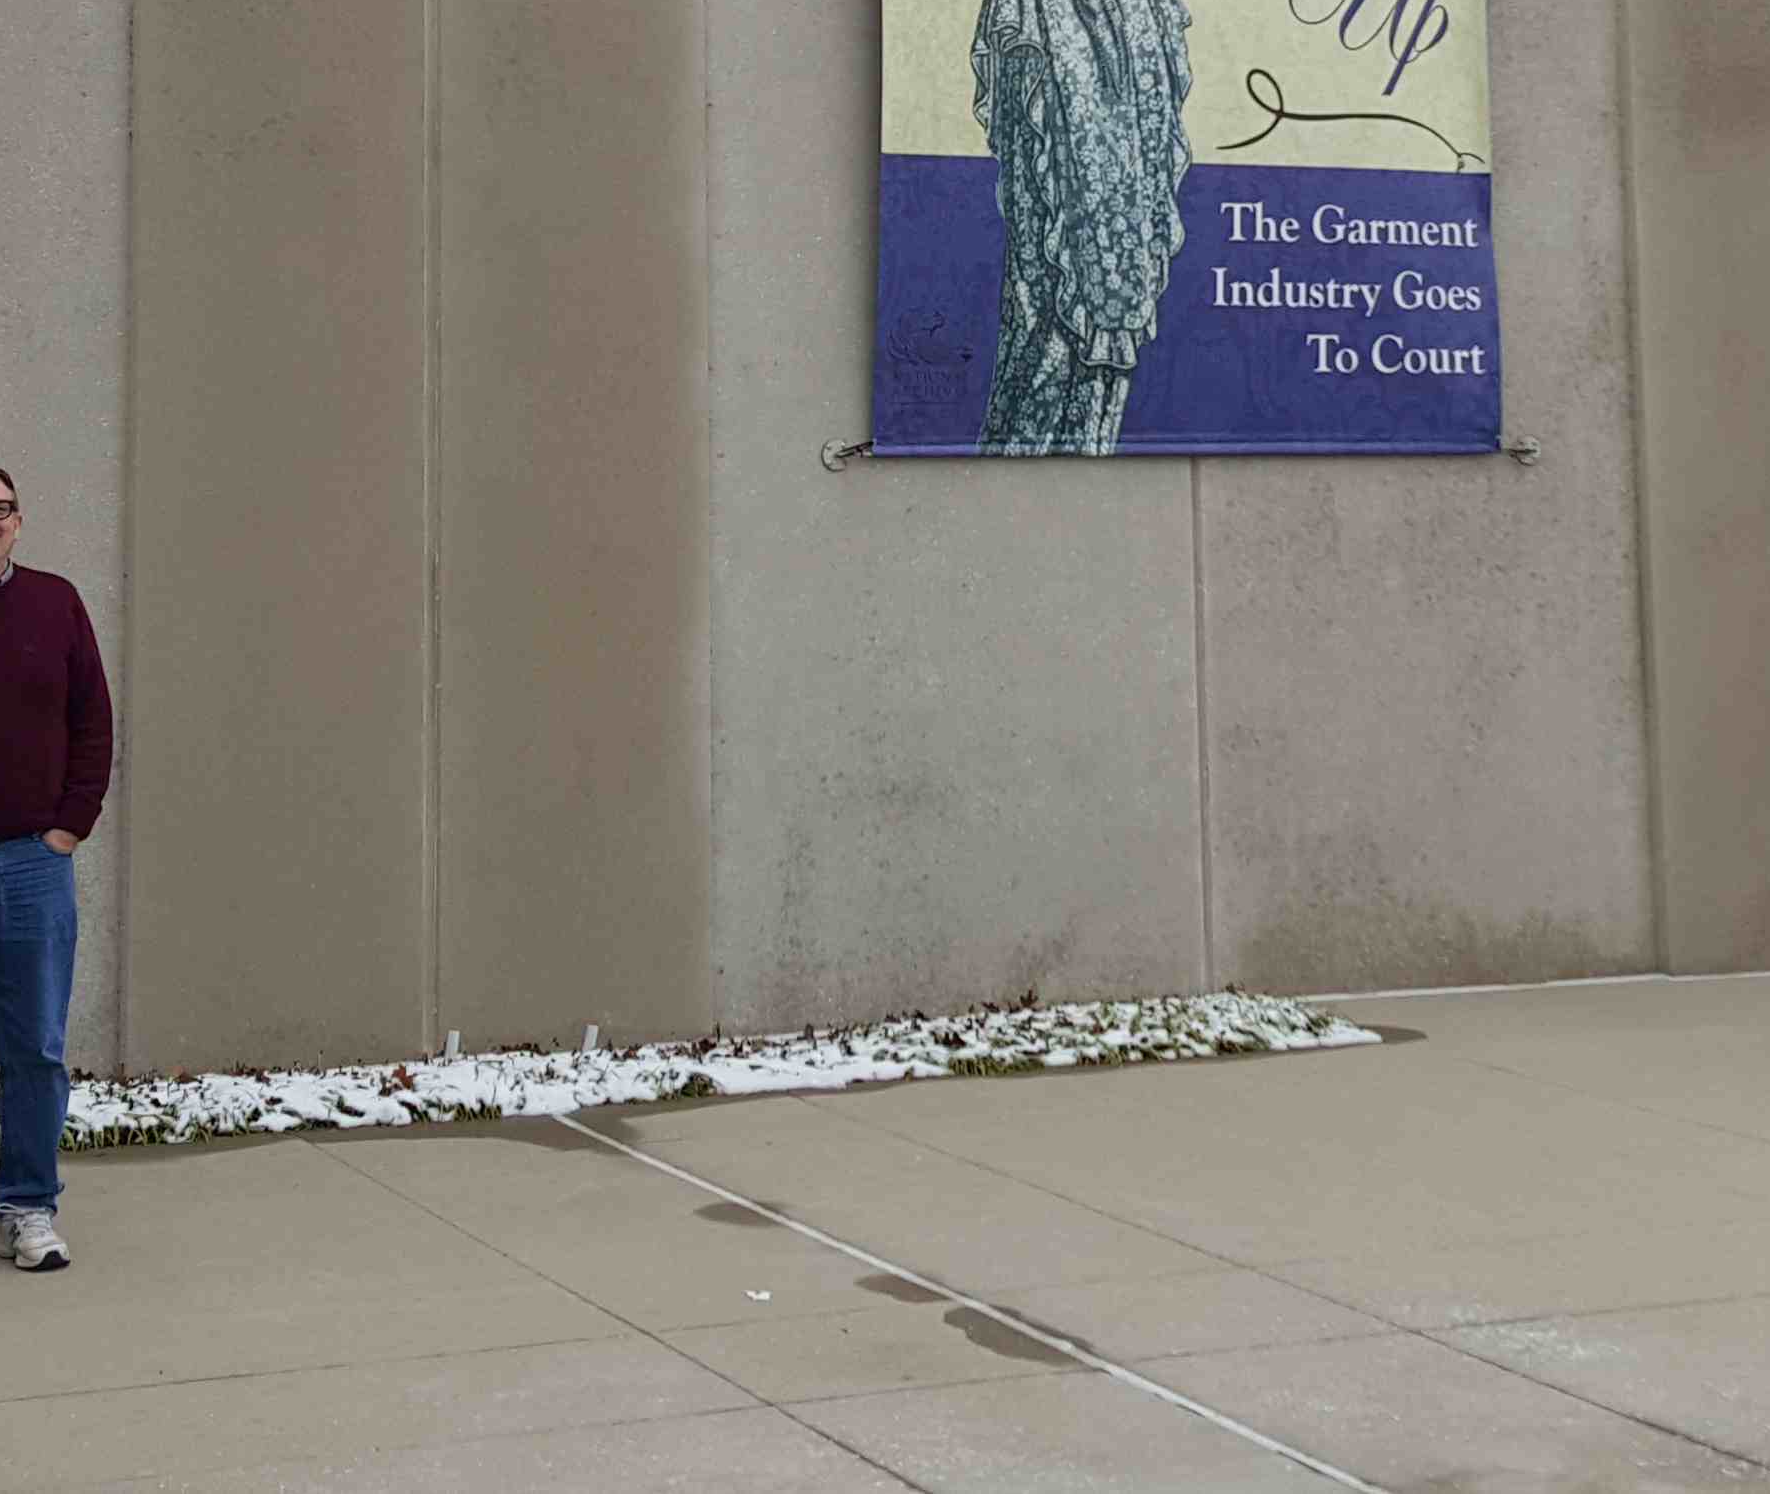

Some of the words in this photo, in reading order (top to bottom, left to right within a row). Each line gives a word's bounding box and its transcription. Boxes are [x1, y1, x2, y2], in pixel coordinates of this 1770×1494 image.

[1220, 201, 1301, 243] The
[1311, 204, 1479, 248] Garment
[1210, 266, 1383, 318] Industry
[1392, 270, 1483, 312] Goes
[1305, 333, 1359, 375] To
[1370, 333, 1487, 375] Court
